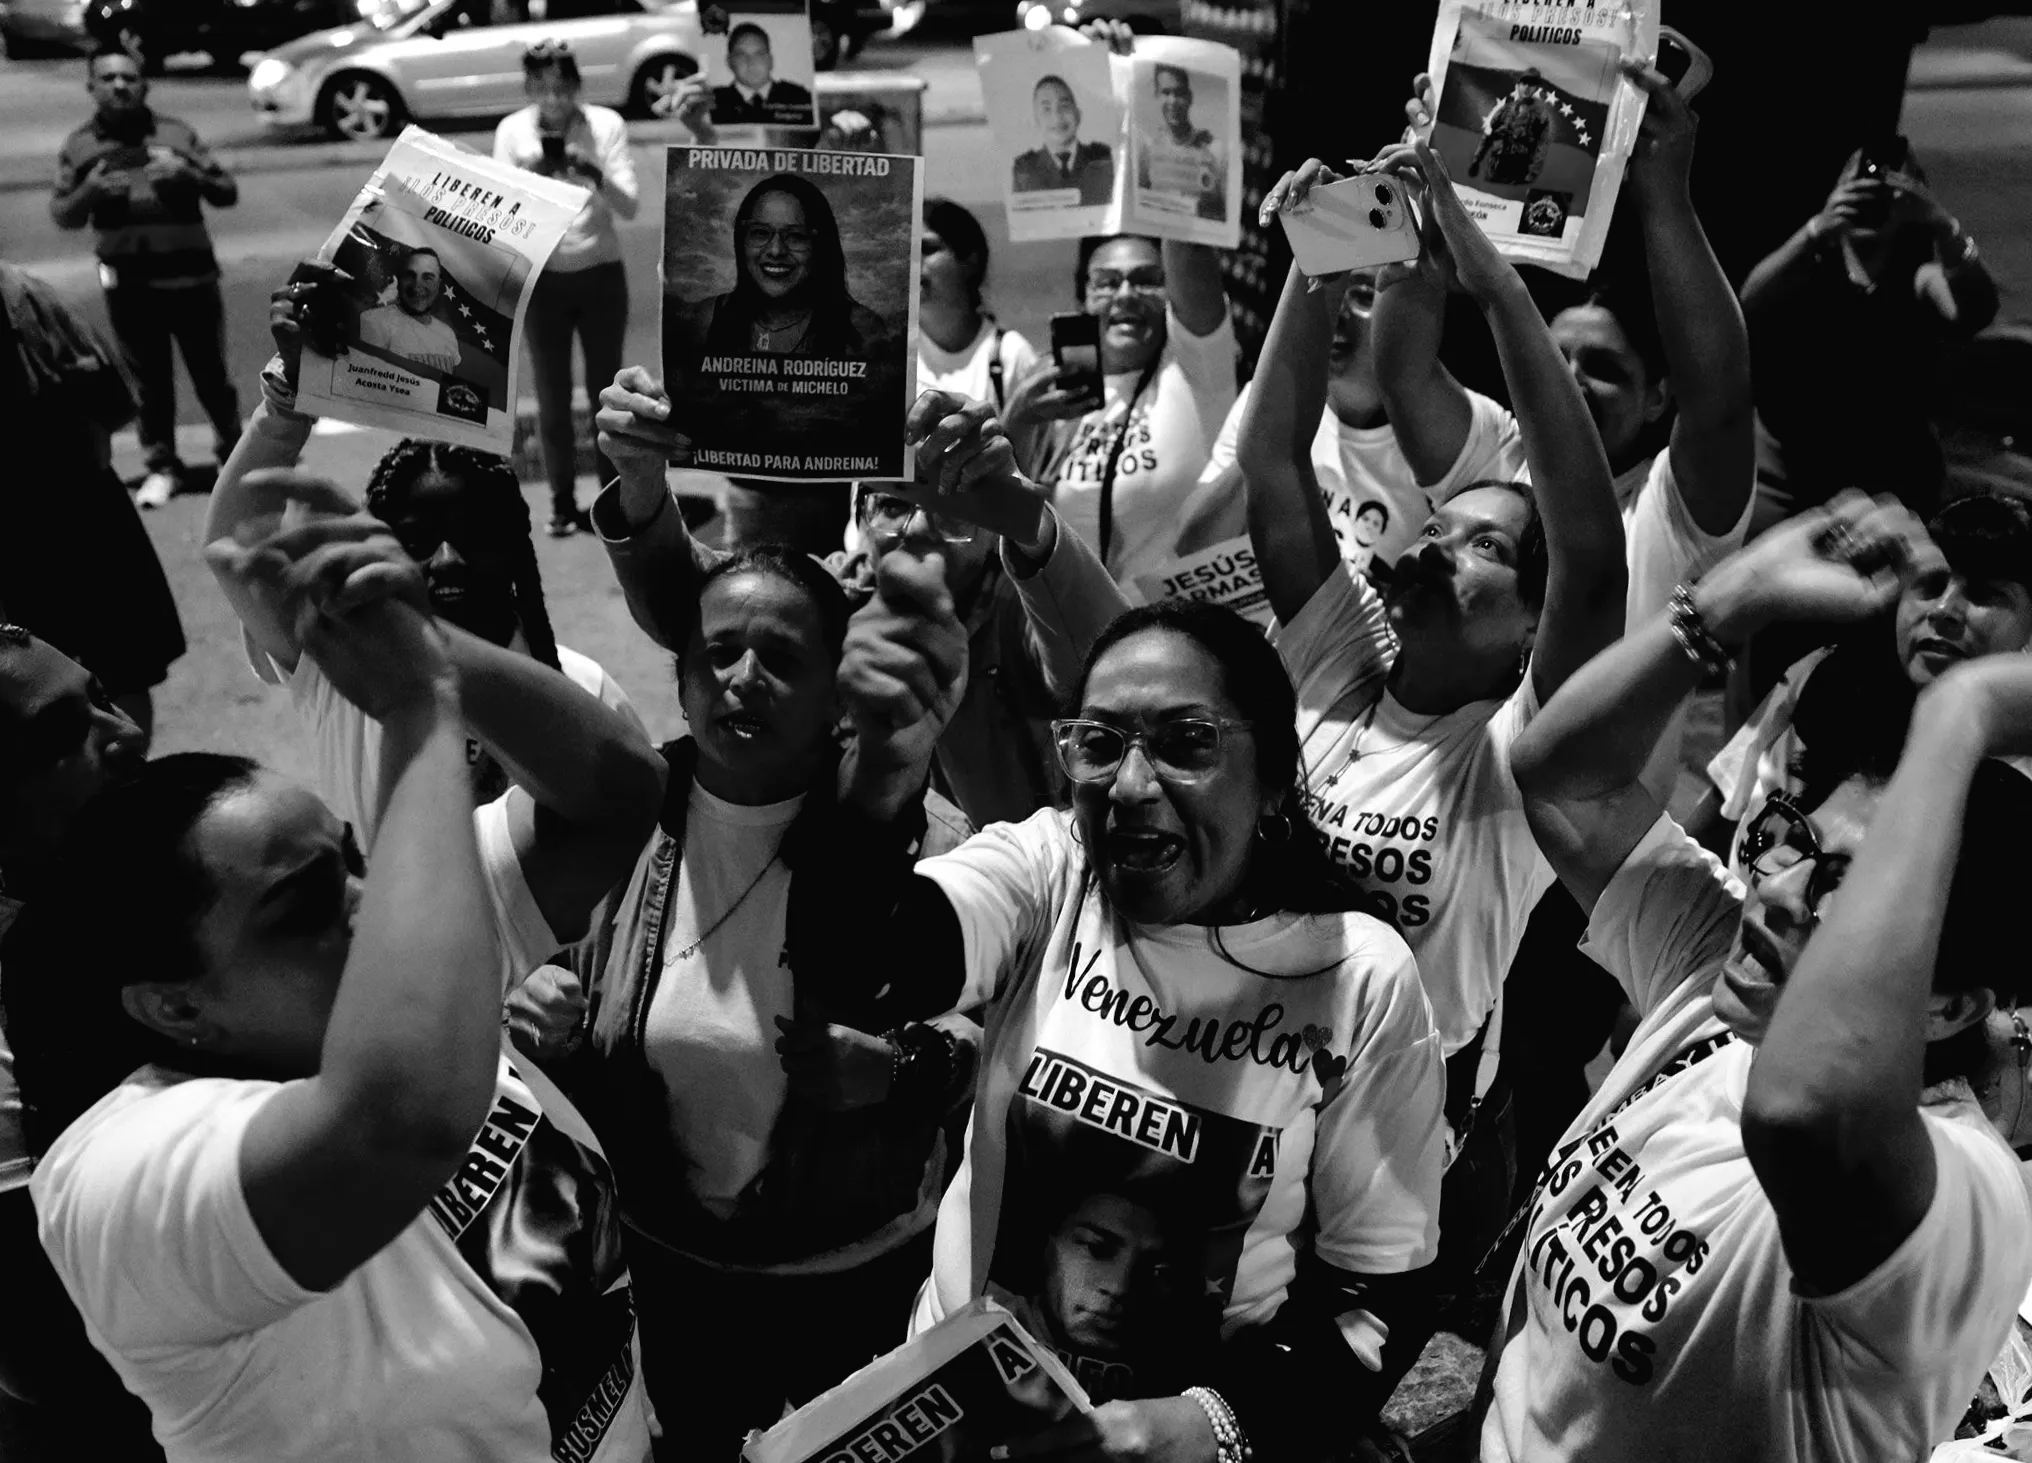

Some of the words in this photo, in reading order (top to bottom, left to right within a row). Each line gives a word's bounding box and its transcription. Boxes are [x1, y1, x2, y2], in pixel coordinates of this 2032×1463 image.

[1510, 24, 1582, 45] POLITICOS
[688, 150, 769, 171] PRIVADA
[774, 152, 797, 172] DE
[802, 154, 890, 177] LIBERTAD
[432, 172, 504, 208] LIBEREN
[508, 202, 521, 215] A
[1474, 200, 1507, 211] Fonseca
[424, 205, 496, 245] POLITICOS
[451, 195, 537, 240] PRESOS!
[348, 363, 395, 380] Juanfredd
[355, 378, 387, 391] Acosta
[701, 357, 778, 375] ANDREINA
[784, 358, 867, 378] RODRÍGUEZ
[719, 378, 774, 392] VICTIMA
[777, 382, 789, 392] DE
[792, 381, 848, 395] MICHELO
[693, 449, 761, 468] ¡LIBERTAD
[764, 454, 801, 470] PARA
[804, 457, 879, 471] ANDREINA!
[1163, 549, 1256, 597] JESÚS
[1176, 568, 1262, 601] RMAS
[1329, 804, 1348, 828] A
[1353, 812, 1439, 842] TODOS
[1065, 941, 1311, 1074] Venezuela
[1018, 1053, 1200, 1163] LIBEREN
[1250, 1132, 1277, 1178] A
[427, 1095, 540, 1240] IBEREN
[1633, 1190, 1710, 1275] TODOS
[1566, 1184, 1682, 1323] PRESOS
[989, 1337, 1037, 1385] A
